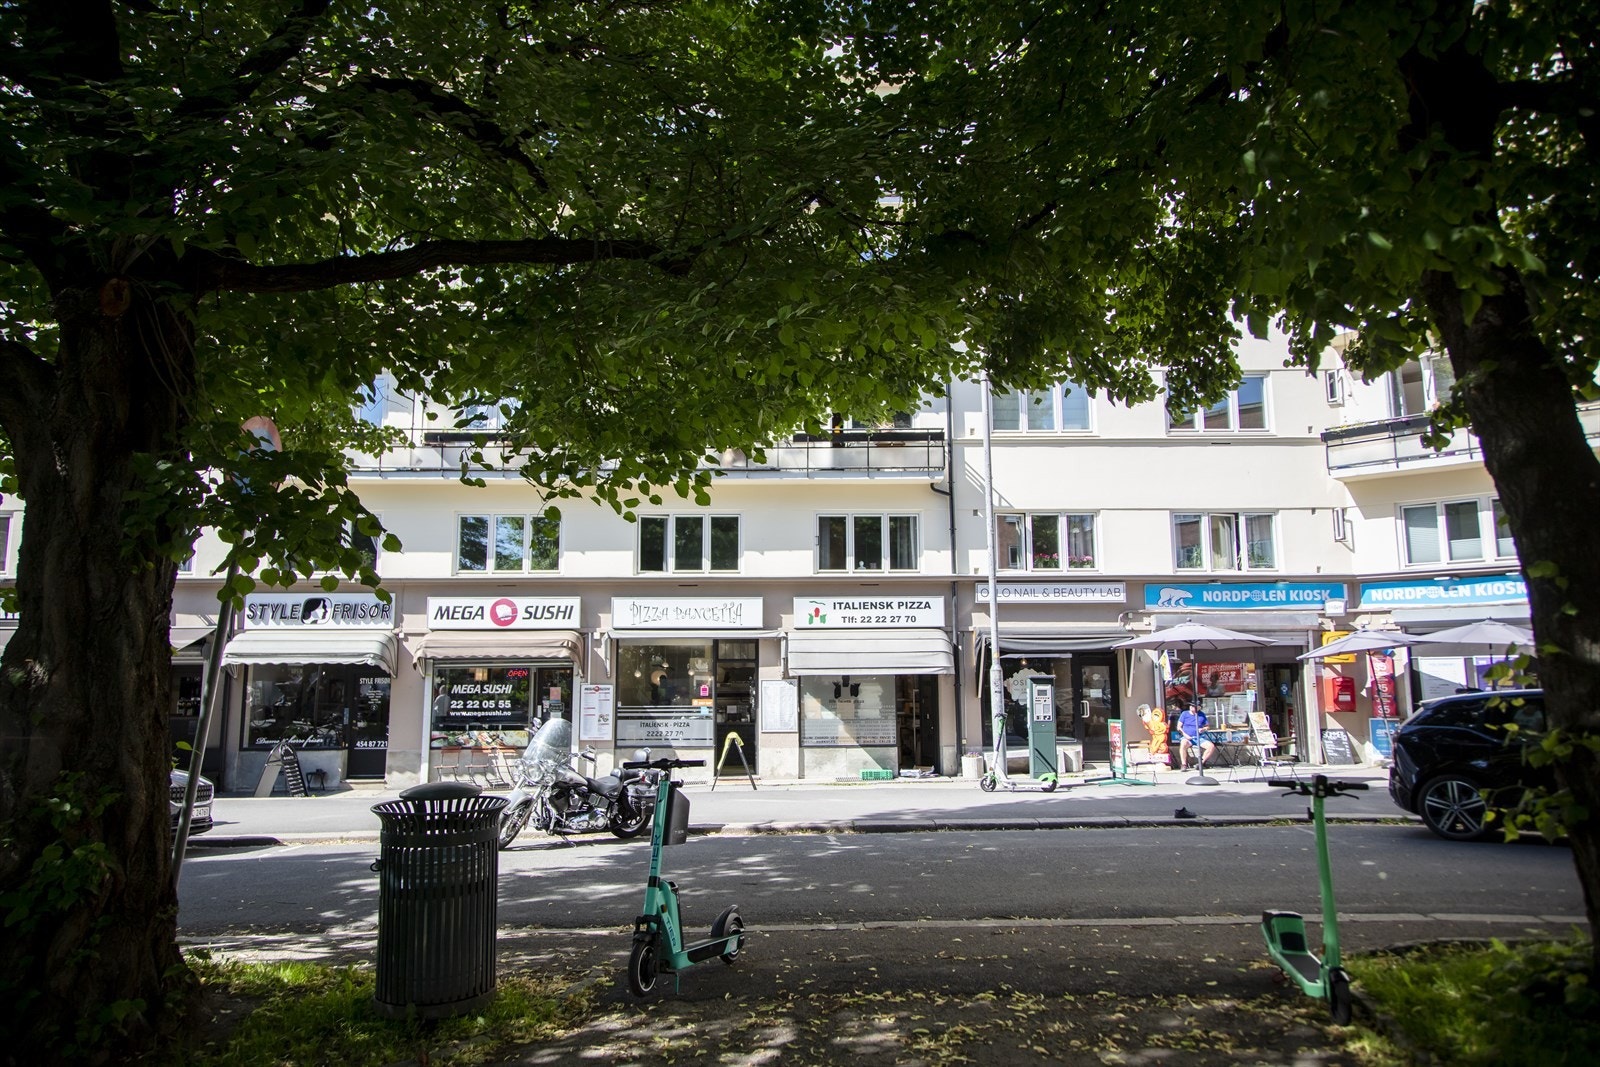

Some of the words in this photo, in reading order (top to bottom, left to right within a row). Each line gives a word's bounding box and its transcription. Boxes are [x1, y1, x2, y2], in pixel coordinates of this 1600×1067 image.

[980, 588, 1011, 598] OLO
[1014, 588, 1040, 598] NAIL
[1041, 588, 1050, 598] &
[1053, 587, 1097, 598] BEAUTY
[1099, 587, 1122, 597] LAB
[1290, 589, 1330, 601] KIOSK
[246, 602, 301, 620] STYLE
[331, 602, 391, 620] FRISØR
[833, 601, 894, 610] ITALIENSK
[897, 601, 932, 610] PIZZA
[433, 605, 485, 621] MEGA
[521, 605, 575, 620] SUSHI
[630, 601, 669, 626] PIZZA
[673, 602, 743, 626] PANCETTA
[841, 616, 858, 624] Tlf:
[860, 616, 872, 624] 22
[904, 615, 917, 623] 70
[359, 677, 373, 685] STYLE
[451, 684, 481, 694] MEGA
[482, 684, 513, 694] SUSHI
[450, 700, 463, 709] 22
[466, 700, 479, 709] 22
[482, 700, 496, 709] 05
[498, 700, 512, 709] 55
[377, 740, 387, 748] 721
[651, 834, 661, 870] TIER
[665, 917, 677, 947] TIER
